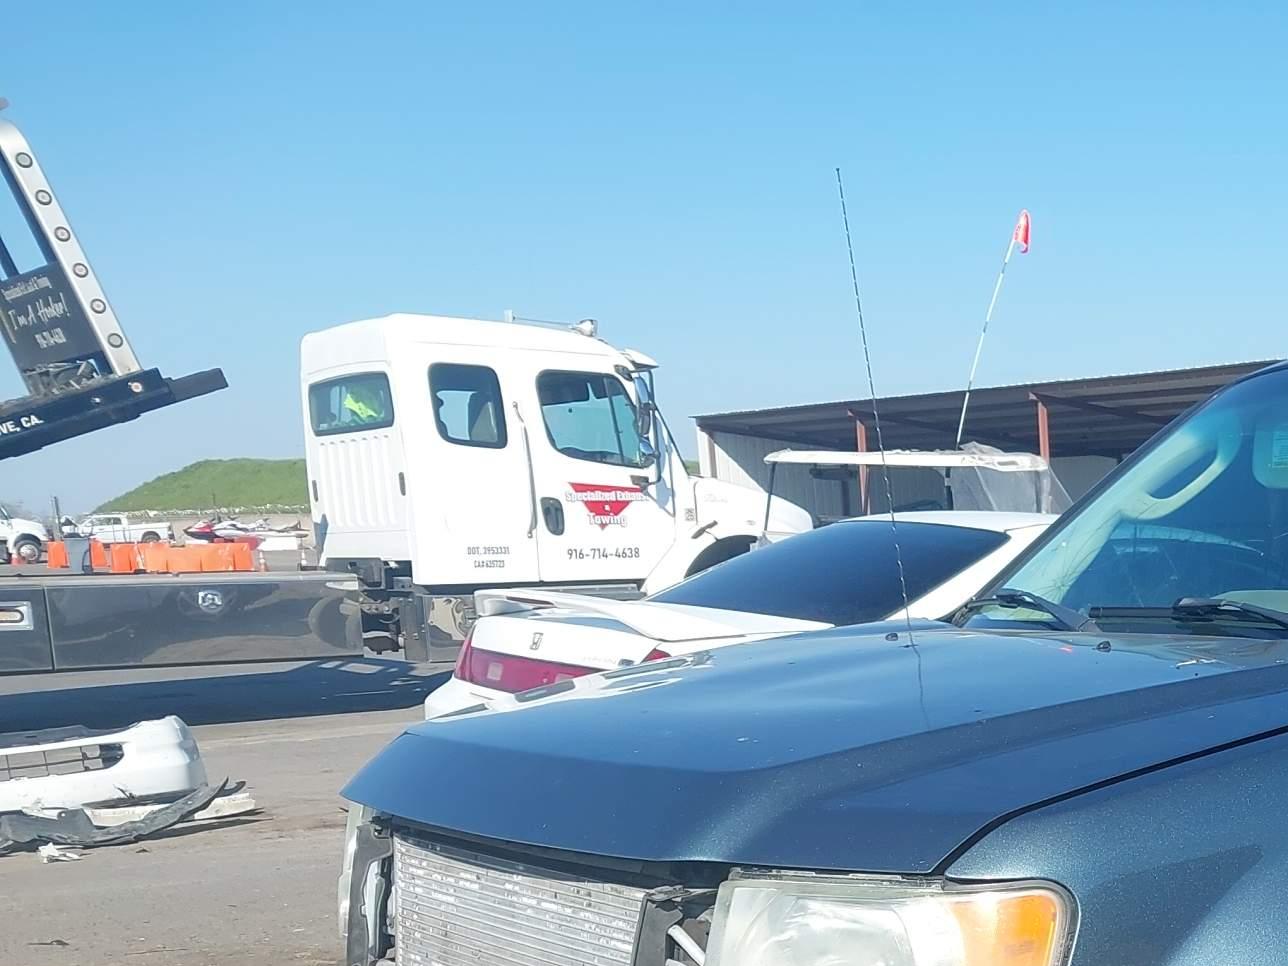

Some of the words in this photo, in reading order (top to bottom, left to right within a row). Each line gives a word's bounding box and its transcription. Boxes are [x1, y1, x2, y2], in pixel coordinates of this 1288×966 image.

[566, 491, 616, 502] Specialized
[616, 491, 650, 502] Exhaus
[587, 512, 627, 528] Towing
[567, 547, 641, 560] 916-714-4638
